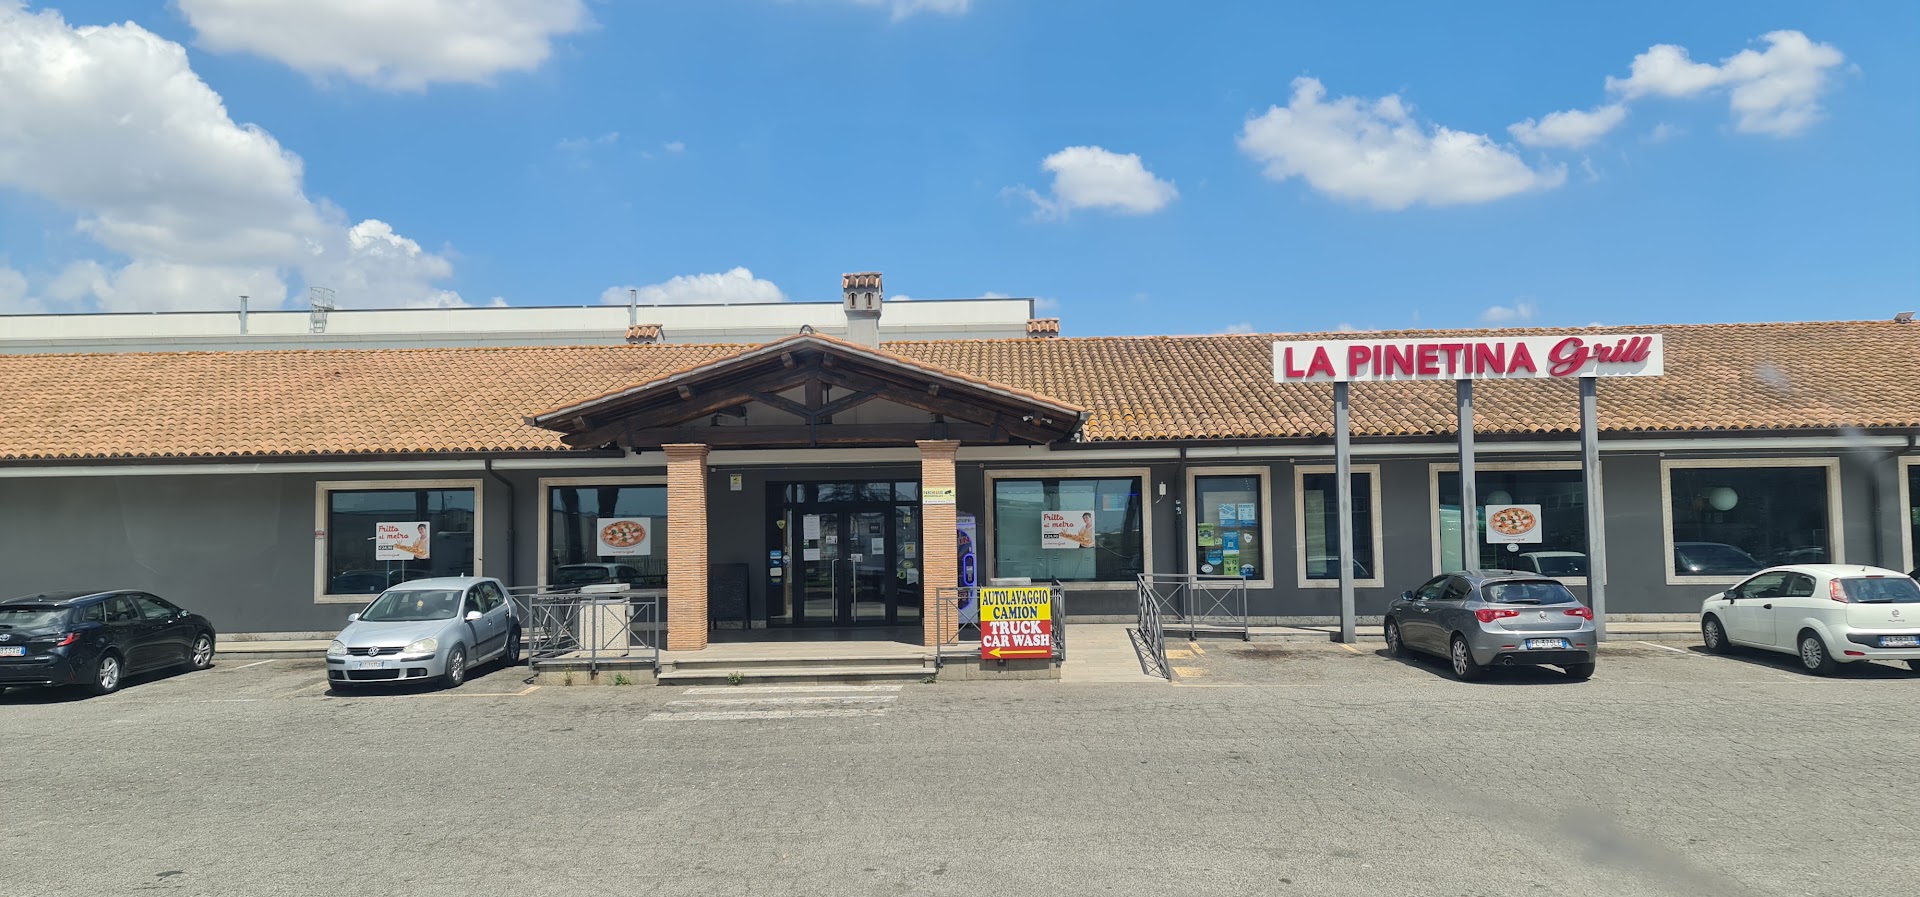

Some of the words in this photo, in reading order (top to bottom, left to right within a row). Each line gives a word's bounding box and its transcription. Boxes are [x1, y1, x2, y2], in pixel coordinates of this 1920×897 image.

[1285, 346, 1336, 378] LA
[1348, 342, 1537, 377] PINETINA
[1548, 336, 1653, 376] Grill
[1043, 513, 1064, 521] Fritto
[378, 525, 400, 533] Fritto
[982, 590, 1048, 606] AUTOLAVAGGIO
[993, 605, 1038, 619] CAMION
[989, 620, 1042, 635] TRUCK
[983, 634, 1010, 647] CAR
[1012, 633, 1050, 647] WASH
